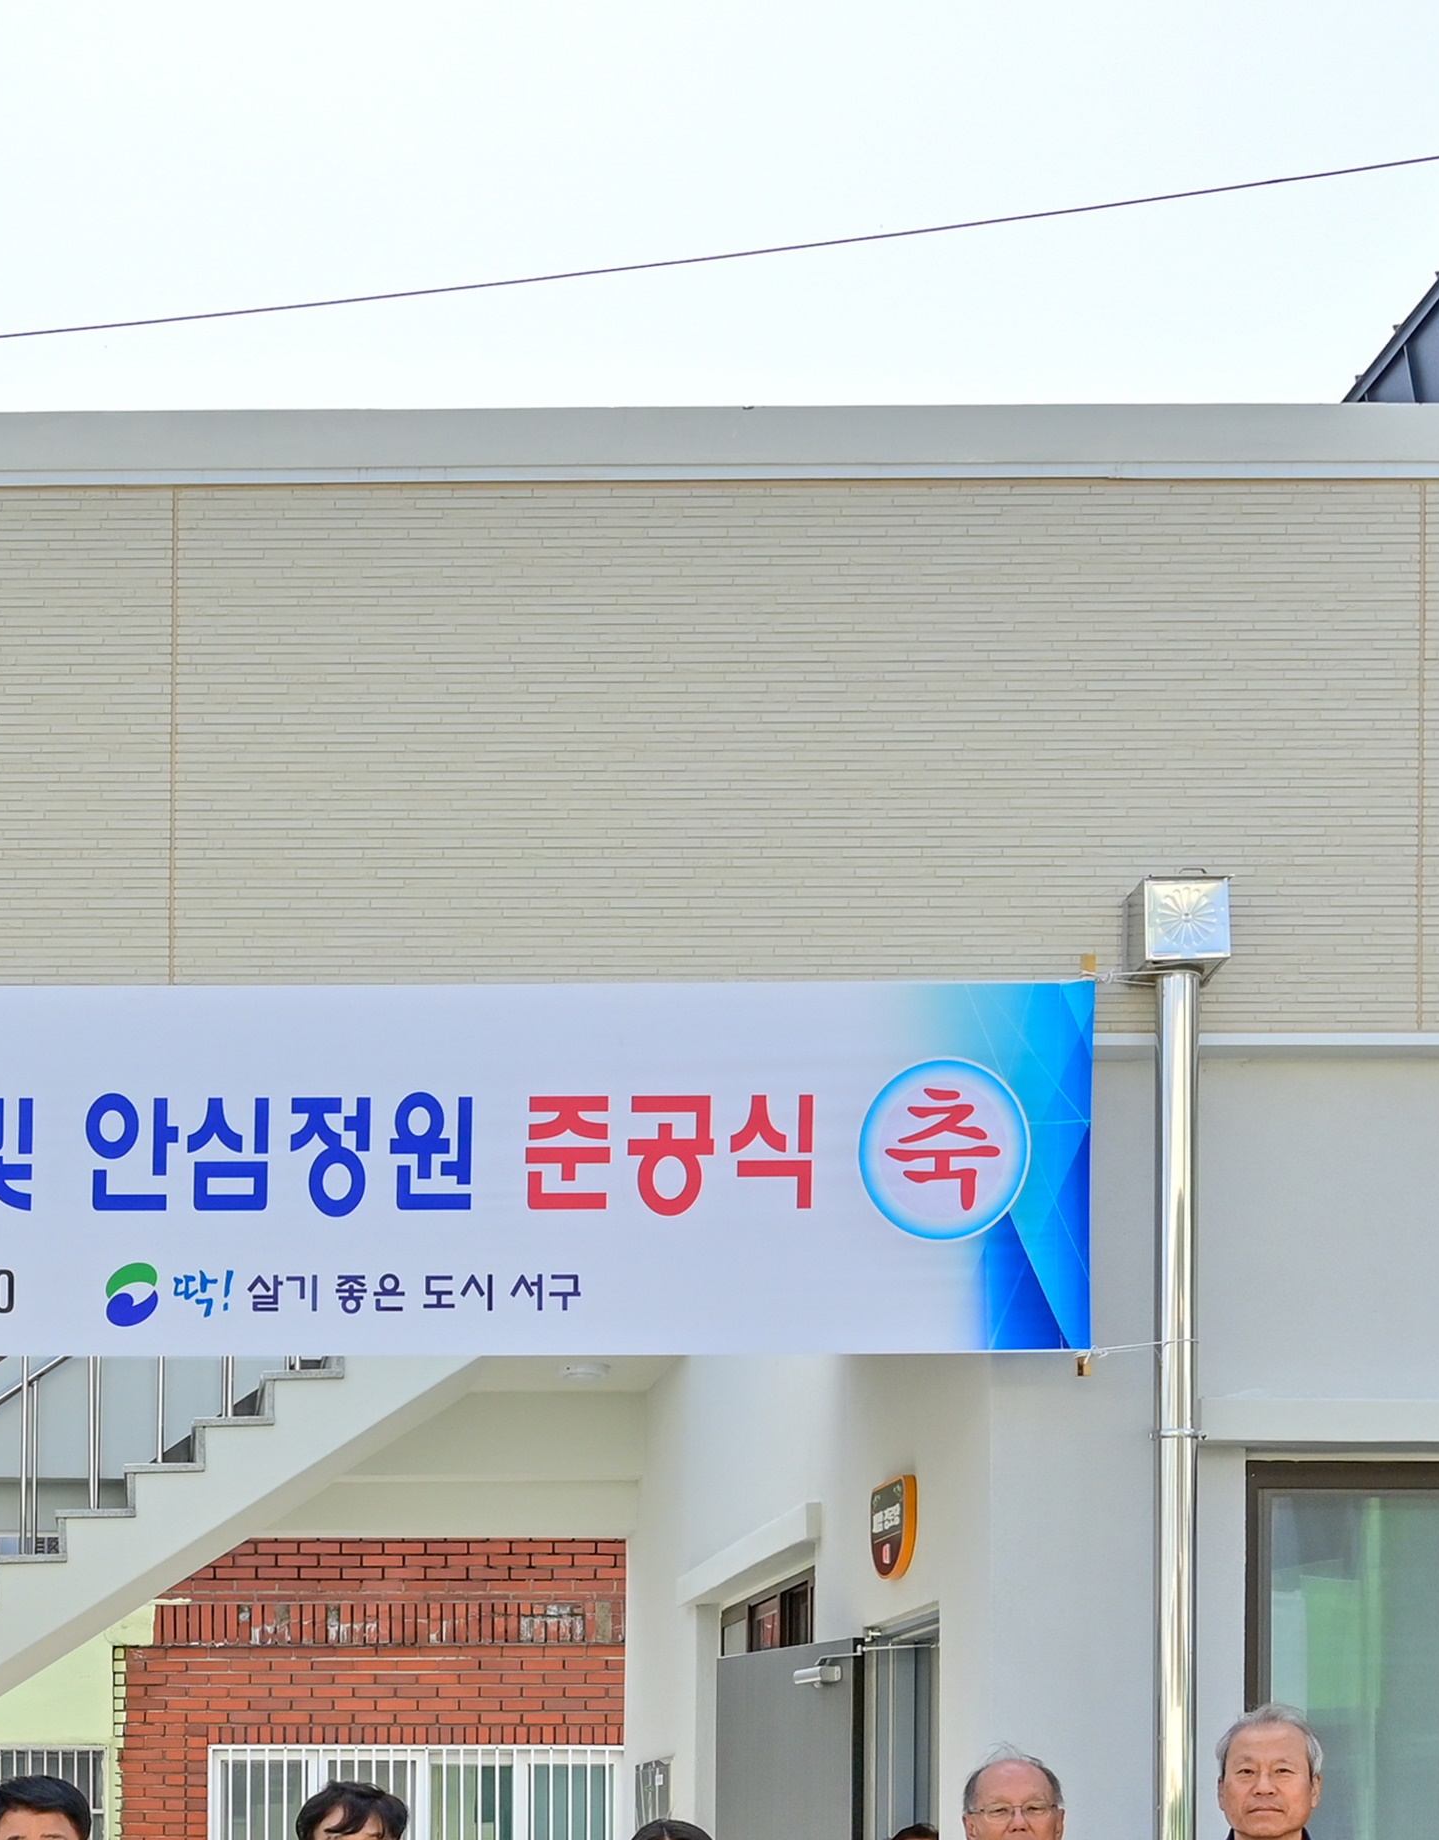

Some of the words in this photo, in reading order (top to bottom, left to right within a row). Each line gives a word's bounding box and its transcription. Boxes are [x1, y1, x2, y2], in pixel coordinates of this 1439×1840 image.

[85, 1091, 473, 1218] 안심정원
[524, 1094, 814, 1217] 준공식
[883, 1087, 1002, 1211] 축
[172, 1269, 234, 1318] 딱!
[246, 1273, 319, 1313] 살기
[334, 1272, 406, 1314] 좋은
[422, 1272, 494, 1312] 도시
[509, 1273, 582, 1312] 서구
